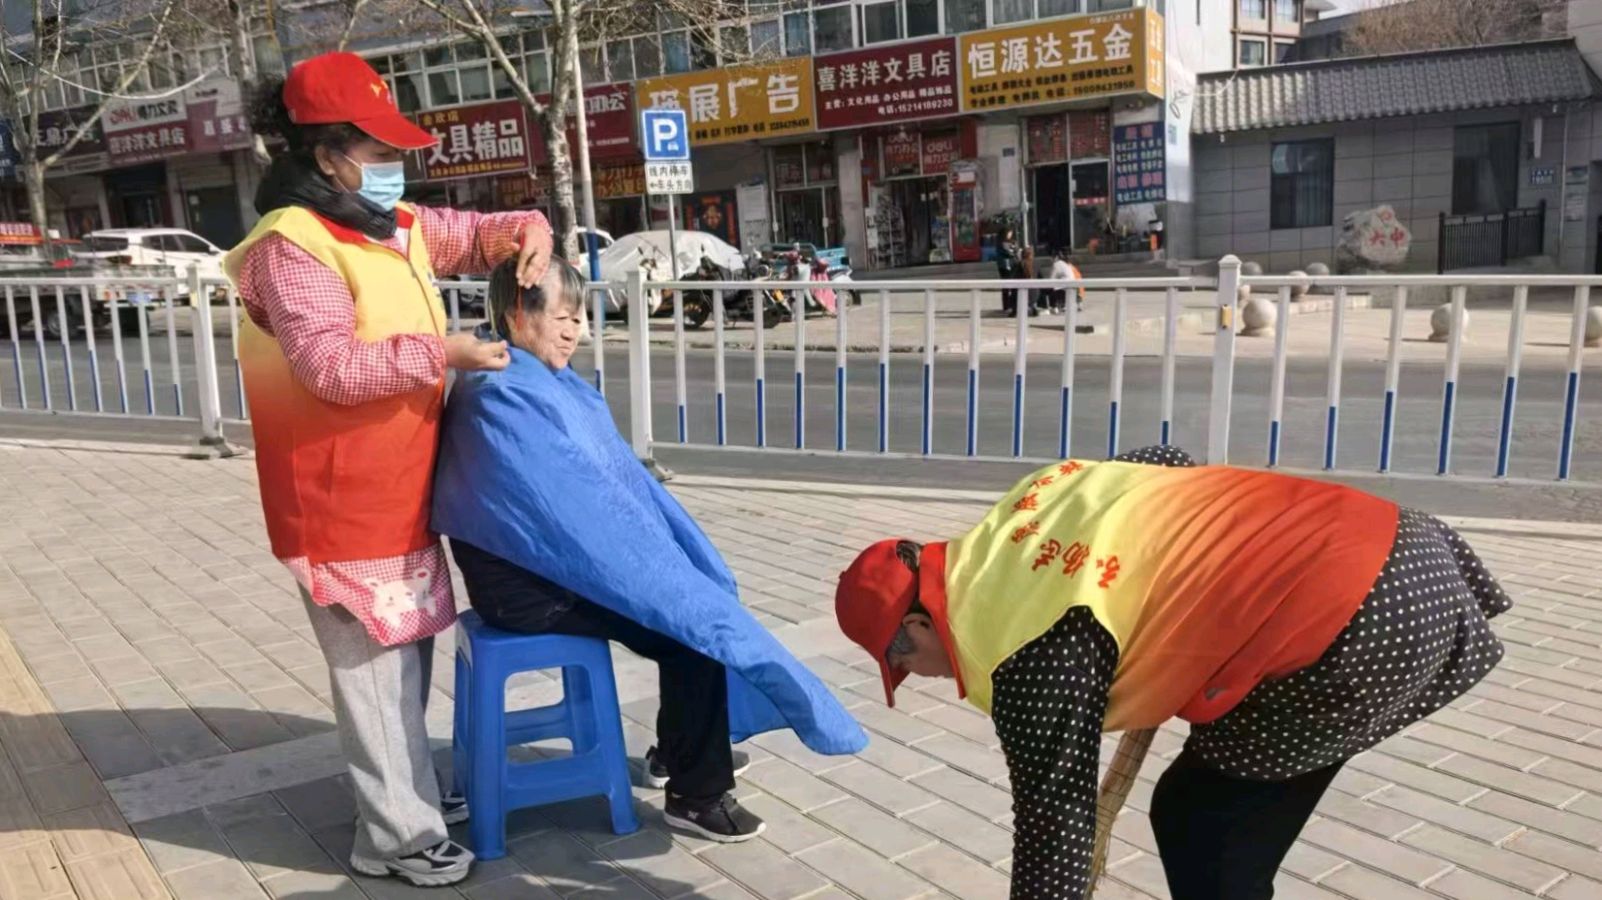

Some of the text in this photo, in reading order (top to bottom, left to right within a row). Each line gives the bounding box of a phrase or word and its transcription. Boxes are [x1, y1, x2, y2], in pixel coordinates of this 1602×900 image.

[816, 50, 951, 92] 喜洋洋文具店
[968, 23, 1134, 79] 恒源达五金
[426, 117, 525, 167] 文具精品
[652, 118, 678, 152] P
[926, 140, 953, 154] deli
